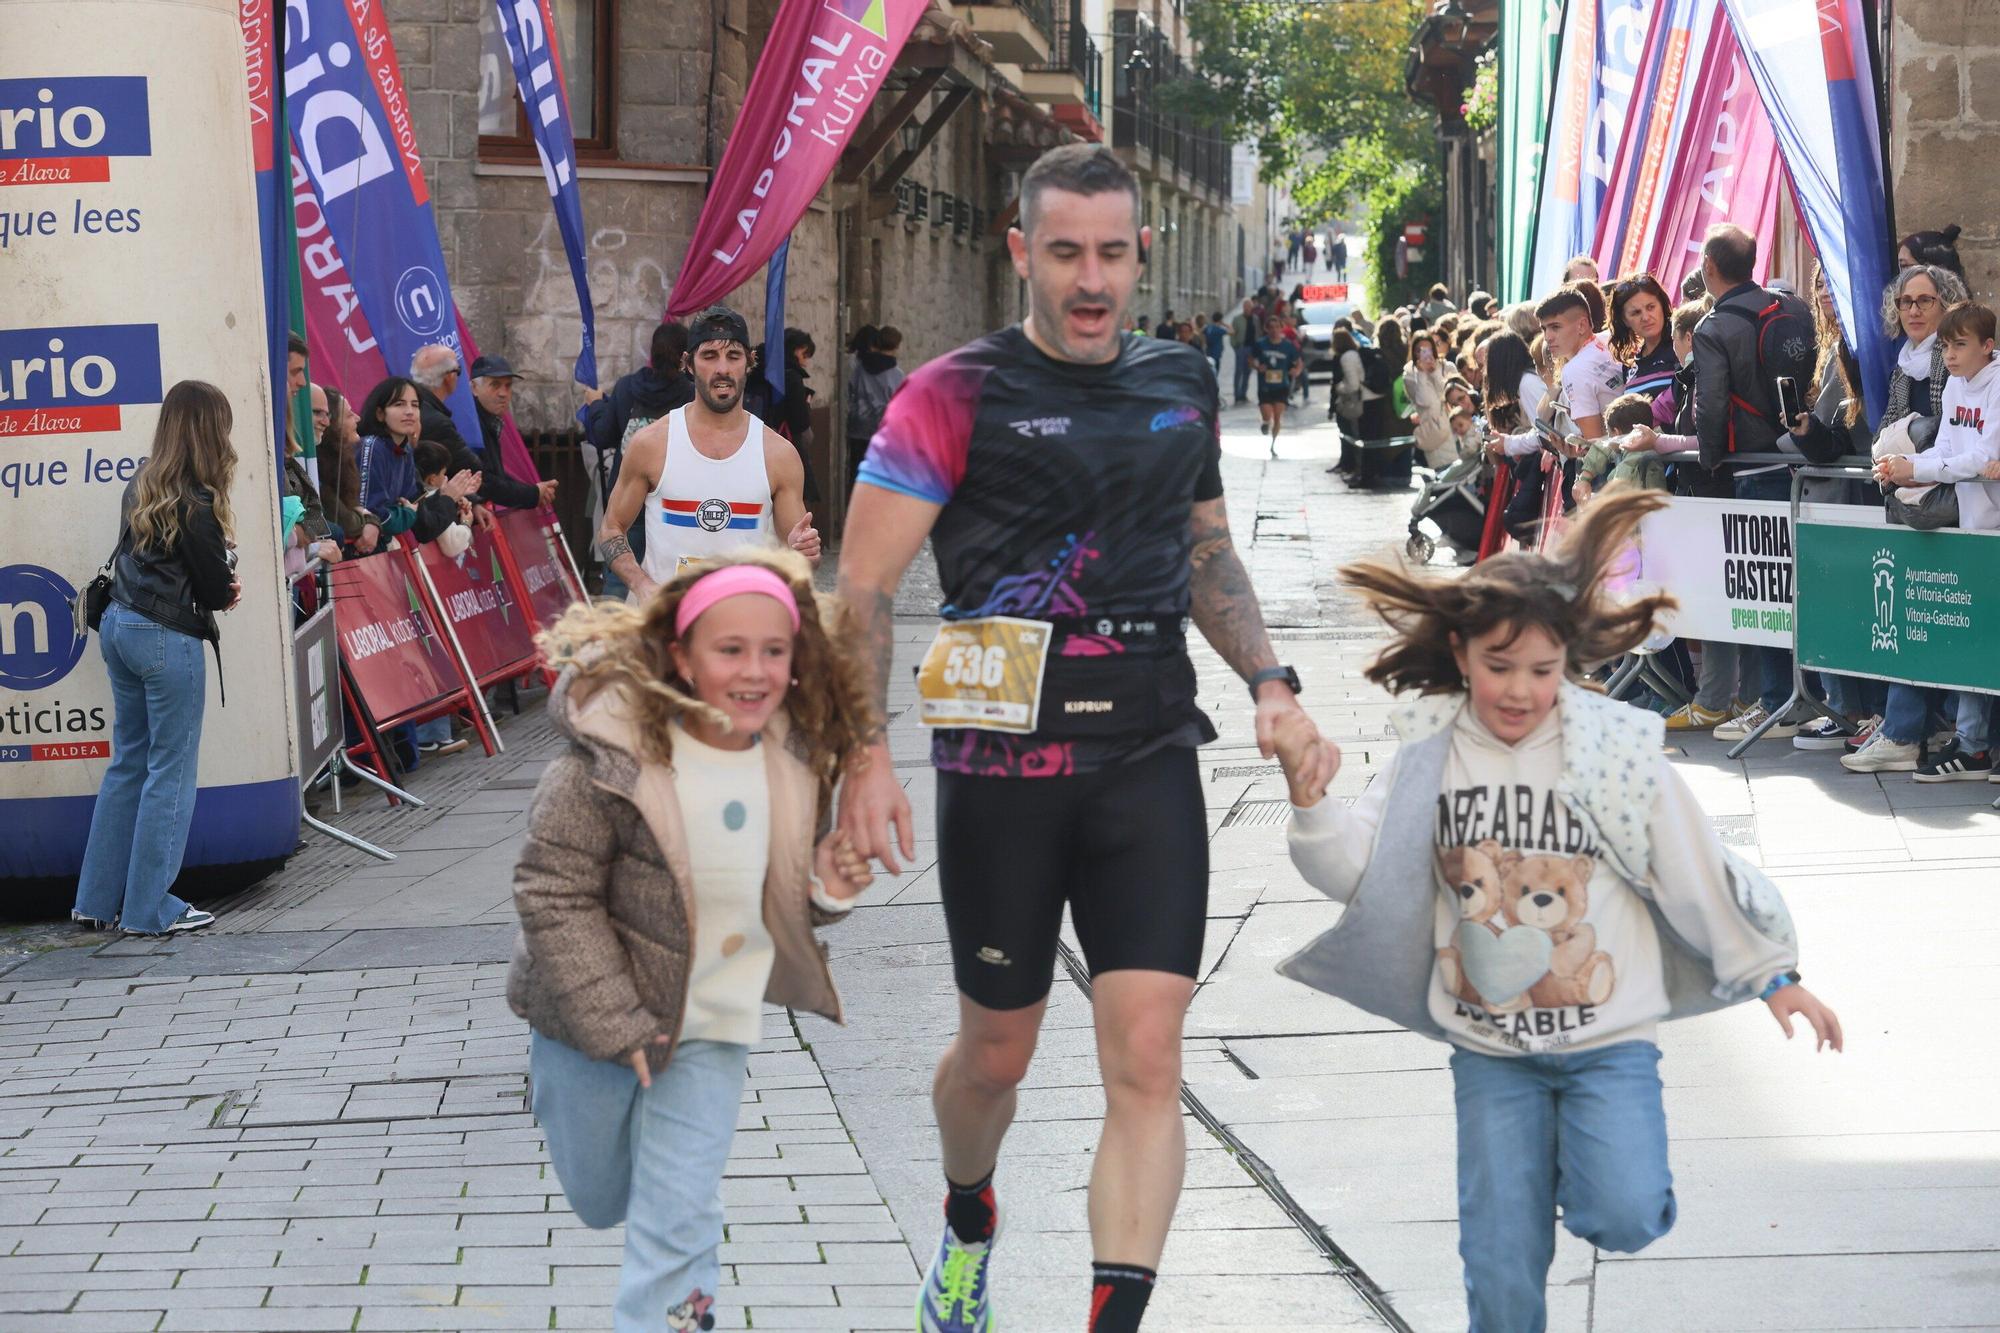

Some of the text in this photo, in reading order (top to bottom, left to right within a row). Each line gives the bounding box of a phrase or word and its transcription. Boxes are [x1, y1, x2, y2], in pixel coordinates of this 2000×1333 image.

[810, 44, 888, 147] kutxa
[11, 158, 71, 182] Álava
[73, 198, 141, 234] lees
[0, 338, 117, 401] rio
[0, 408, 83, 433] de Álava
[1, 448, 150, 498] que lee
[1721, 513, 1792, 558] VITORIA
[1724, 559, 1792, 604] GASTEIZ
[1905, 566, 1958, 585] Ayuntamiento
[1905, 584, 1972, 605] de Vitoria-Gasteiz
[1731, 607, 1759, 630] green
[1905, 607, 1970, 628] Vitoria-Gasteizko
[344, 617, 418, 661] LABORAL kutxa
[1905, 625, 1928, 641] Udala
[943, 644, 1007, 688] 536
[0, 701, 106, 735] ticias
[1064, 700, 1113, 714] KIPRUN
[42, 745, 99, 759] TALDEA
